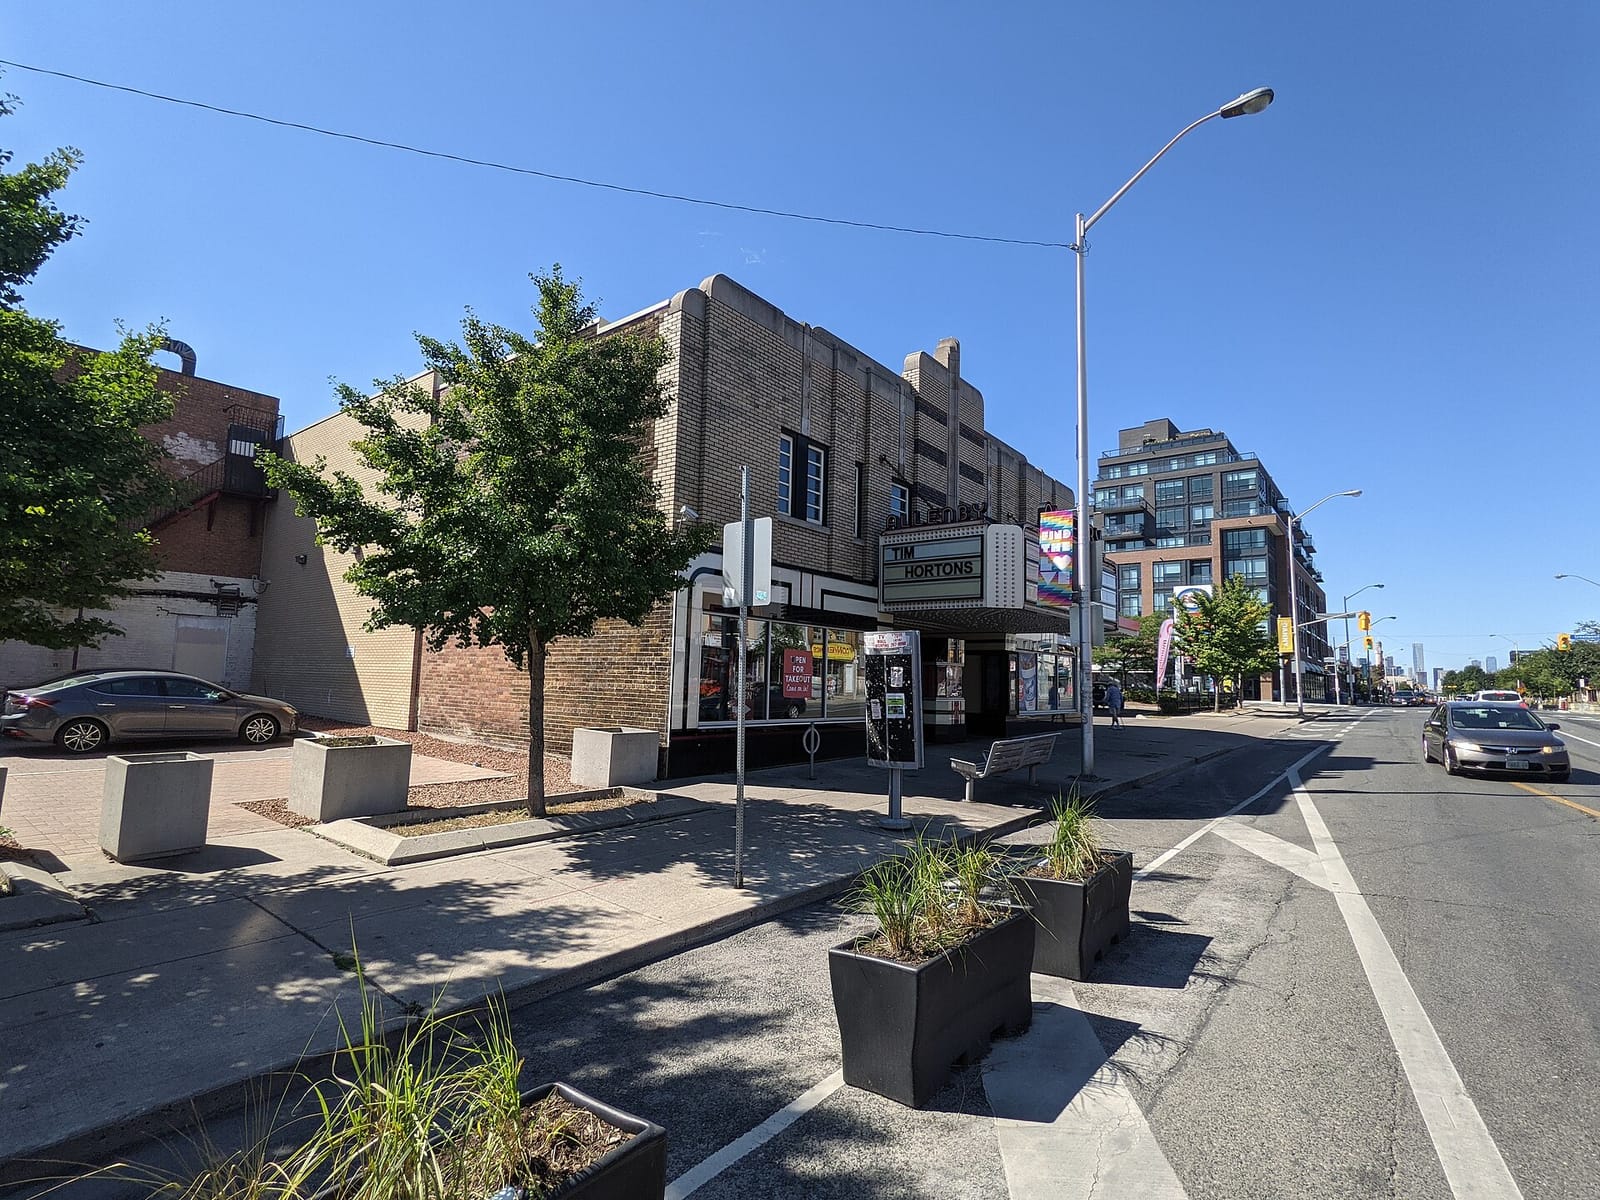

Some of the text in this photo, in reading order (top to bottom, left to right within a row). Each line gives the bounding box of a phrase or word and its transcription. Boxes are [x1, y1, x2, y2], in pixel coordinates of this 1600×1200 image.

[886, 502, 985, 530] ALLENBY
[892, 546, 915, 561] TIM
[1041, 541, 1071, 553] THE
[905, 561, 974, 579] HORTONS
[792, 665, 804, 673] FOR
[785, 675, 810, 683] TAKEOUT
